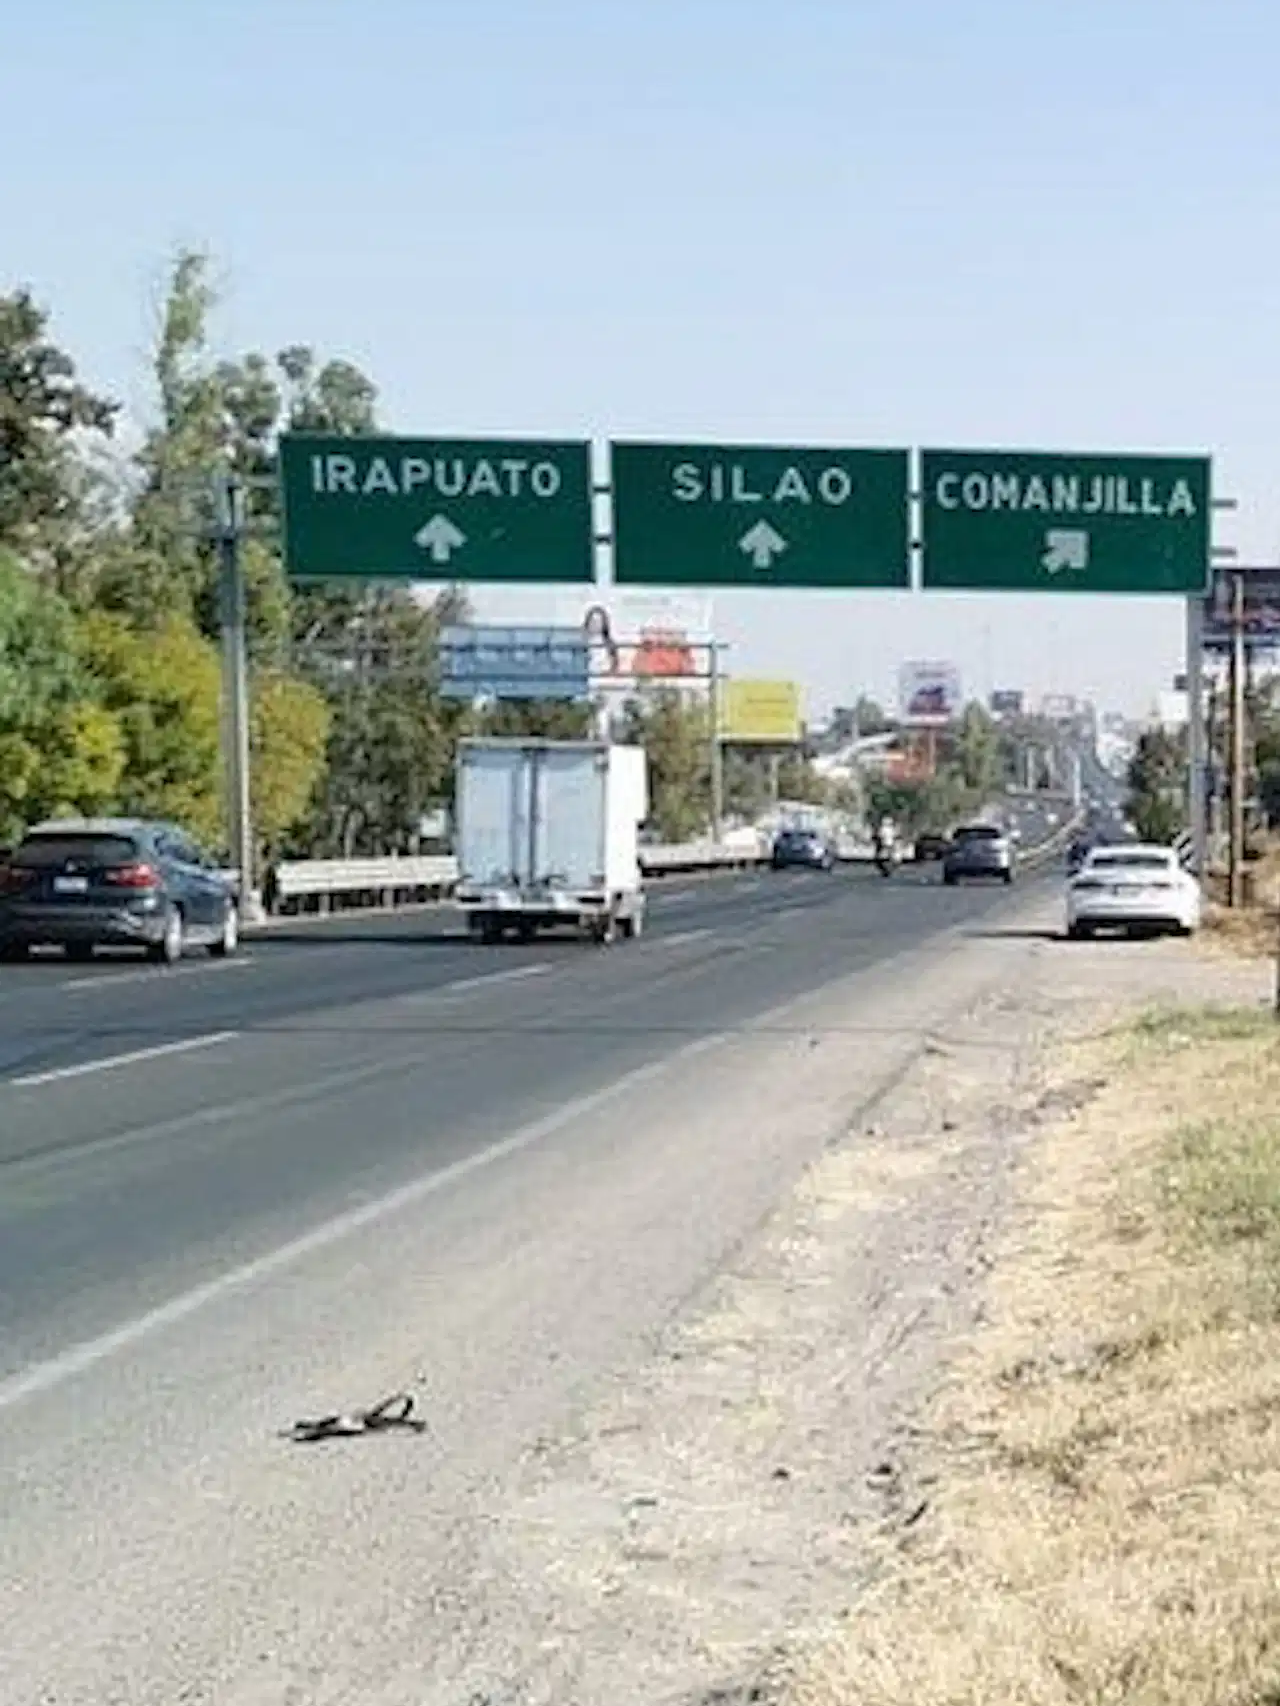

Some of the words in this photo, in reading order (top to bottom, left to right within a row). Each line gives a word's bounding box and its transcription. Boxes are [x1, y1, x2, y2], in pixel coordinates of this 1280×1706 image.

[310, 454, 562, 498] IRAPUATO
[672, 462, 852, 505] SILAO
[935, 471, 1198, 518] COMANJILLA
